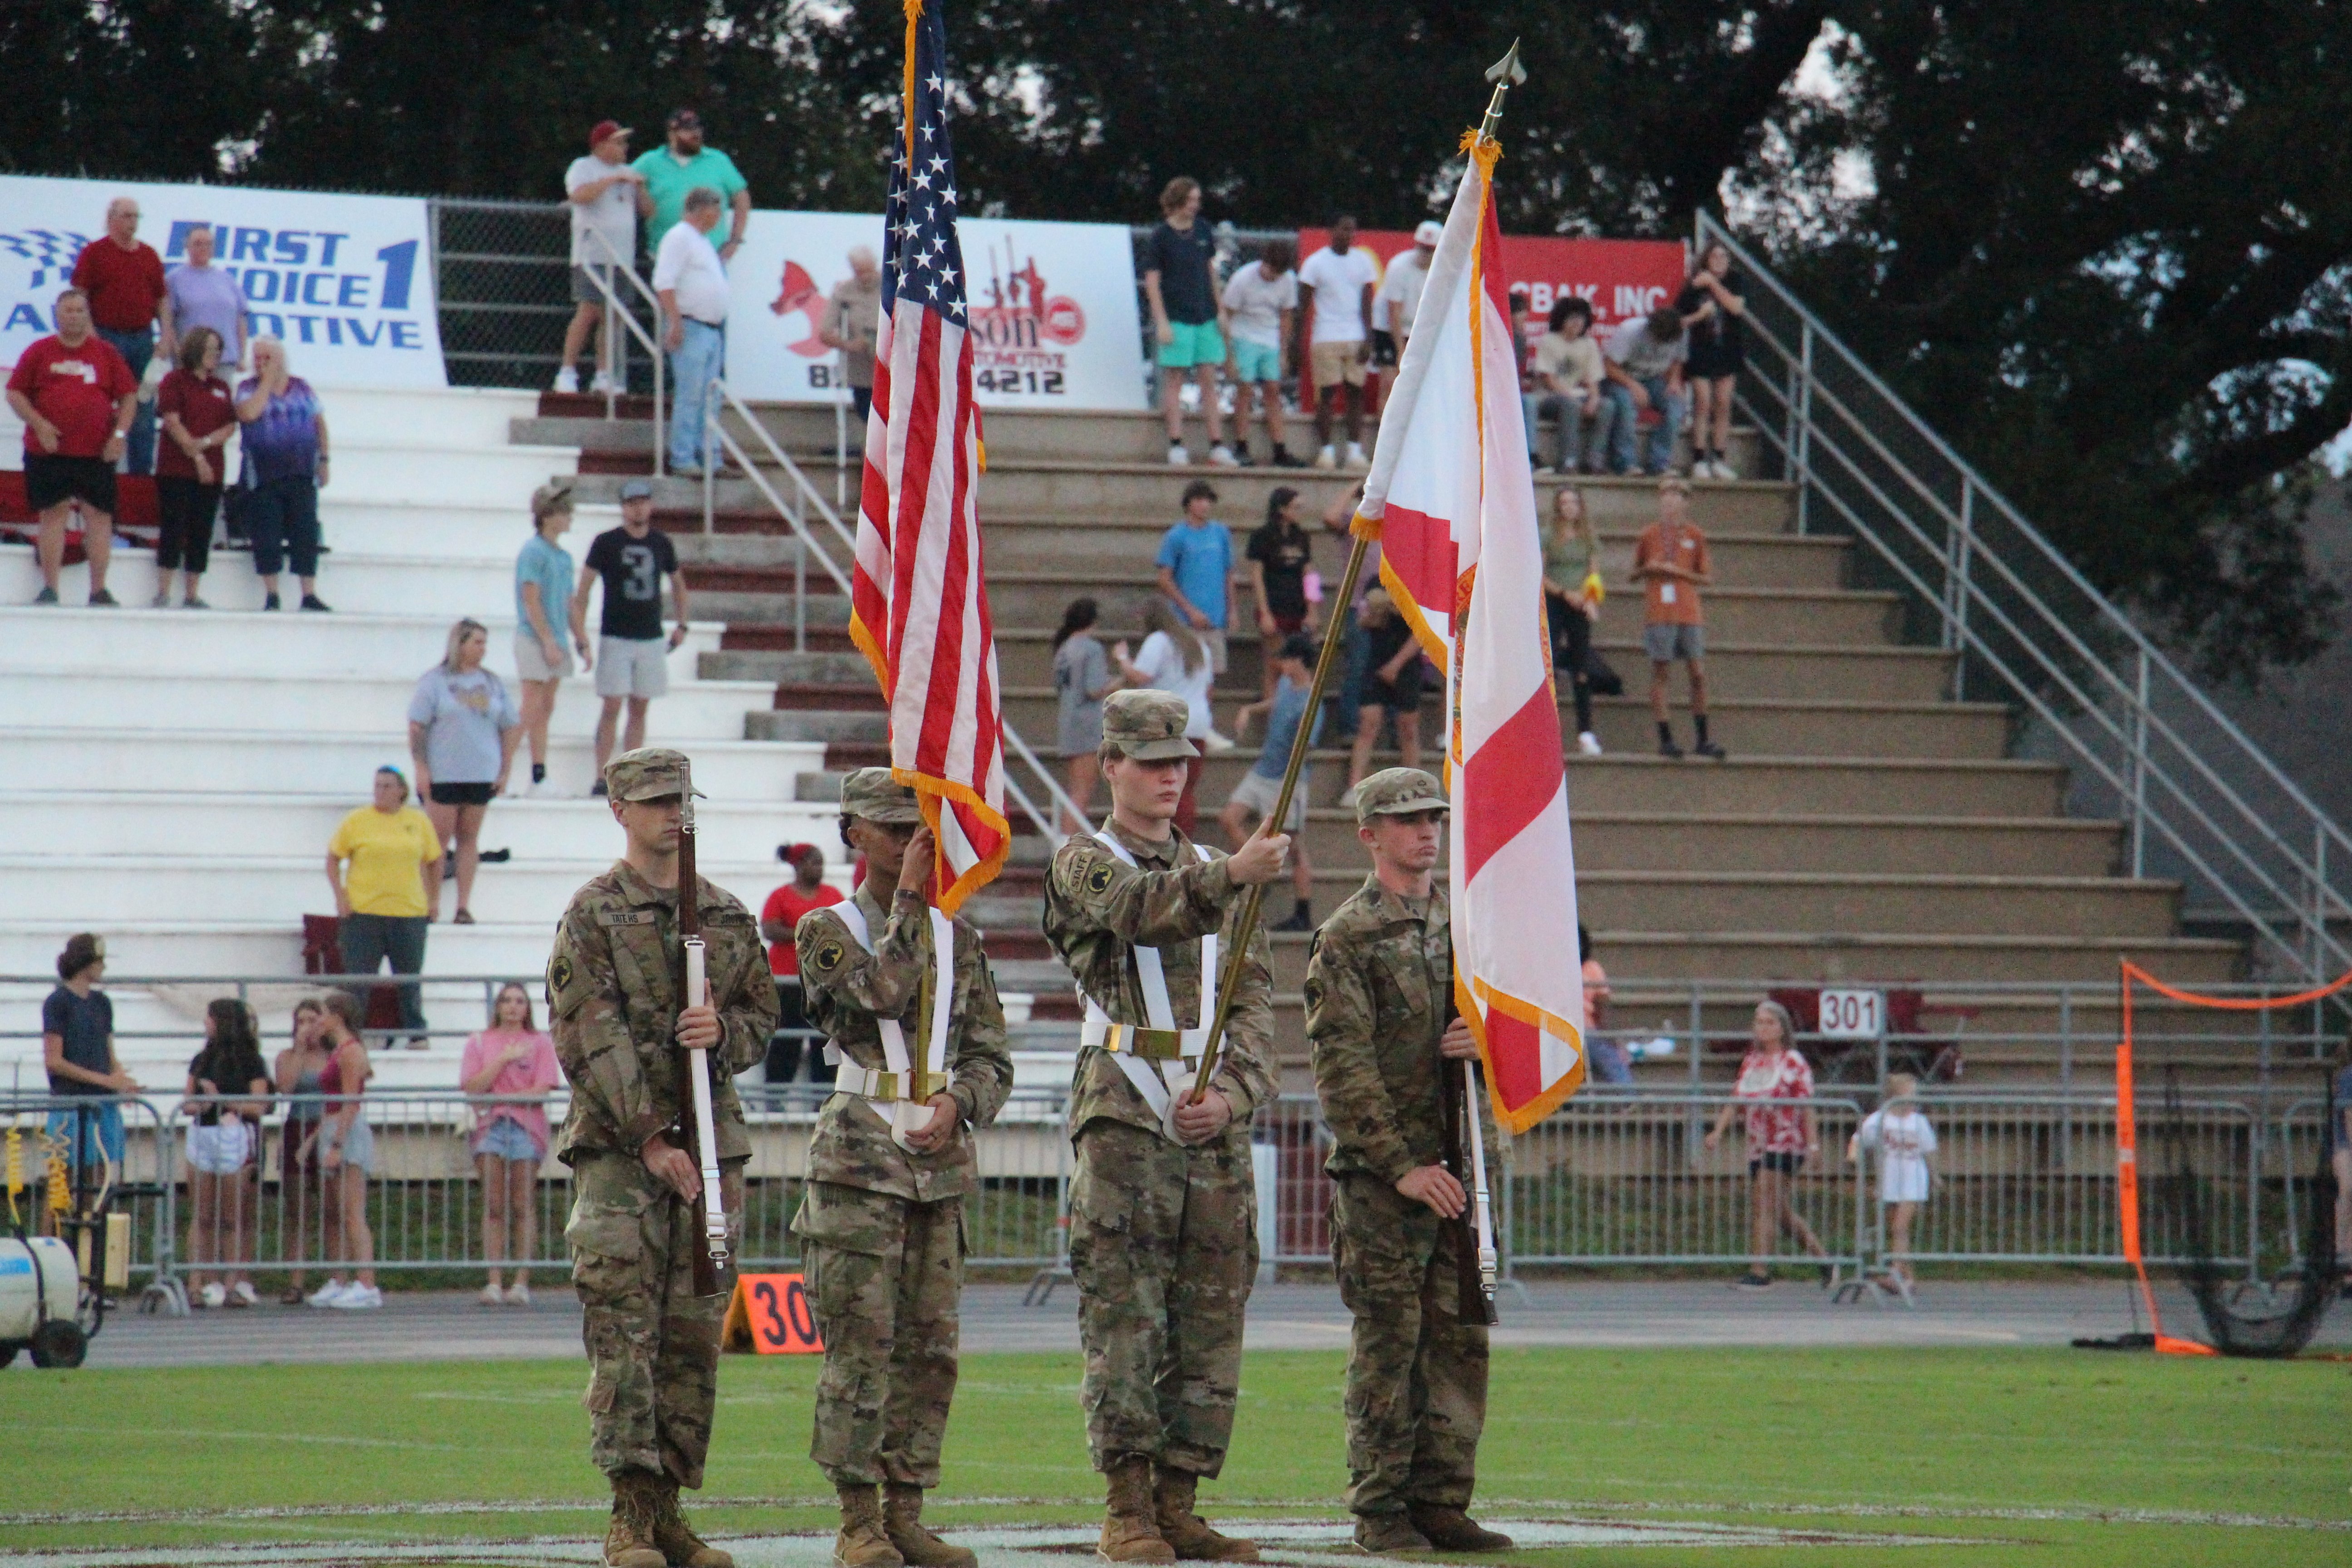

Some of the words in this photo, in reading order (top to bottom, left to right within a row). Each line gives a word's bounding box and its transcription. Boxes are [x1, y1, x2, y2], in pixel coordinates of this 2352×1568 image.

[166, 221, 349, 266] FIRST
[165, 263, 371, 308] OICE
[377, 239, 418, 310] 1
[1072, 856, 1088, 887] STAFF
[611, 914, 627, 923] TATE
[627, 914, 638, 923] HS
[1824, 995, 1875, 1030] 301
[755, 1281, 817, 1346] 30
